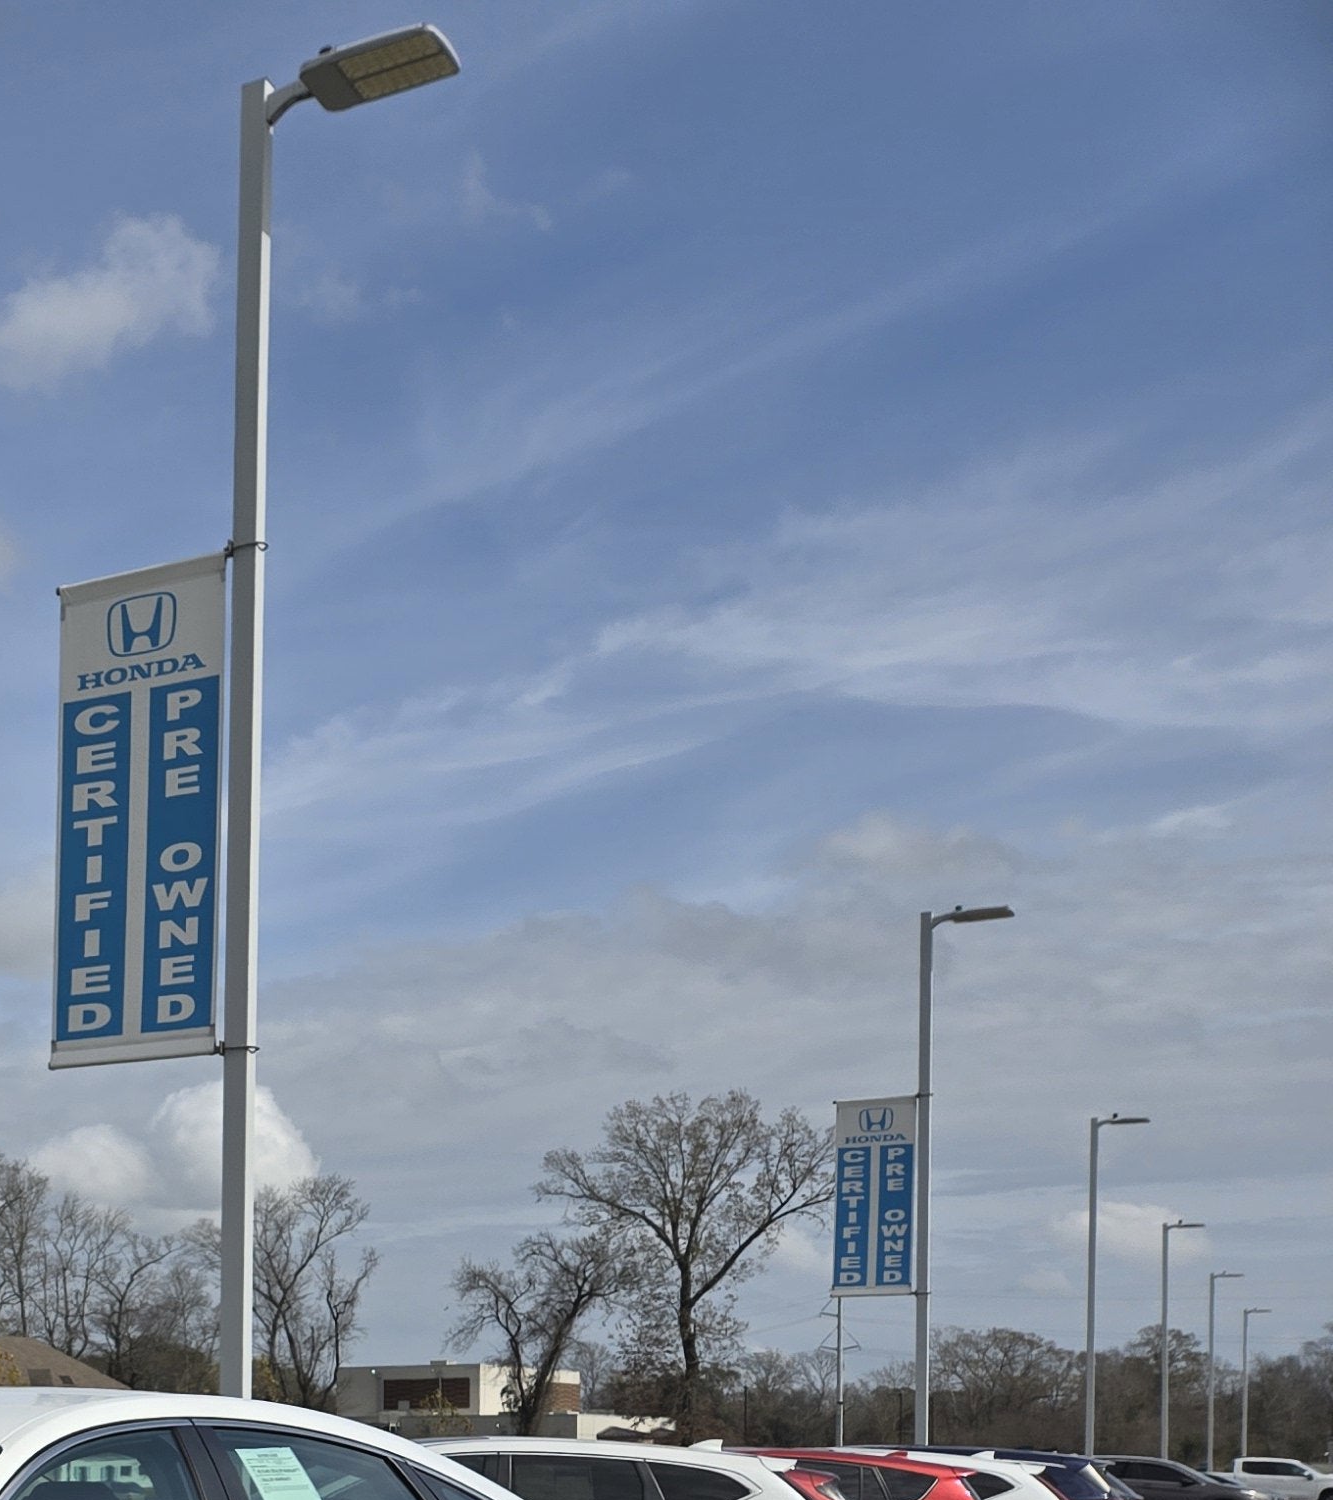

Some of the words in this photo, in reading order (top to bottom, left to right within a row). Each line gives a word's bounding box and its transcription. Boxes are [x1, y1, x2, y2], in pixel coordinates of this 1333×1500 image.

[77, 652, 206, 692] HONDA
[162, 688, 204, 798] PRE
[66, 703, 121, 1034] CERTIFIED
[152, 841, 209, 1025] OWNED
[844, 1133, 907, 1145] HONDA
[885, 1147, 906, 1192] PRE
[839, 1150, 865, 1285] CERTIFIED
[881, 1209, 909, 1284] OWNED
